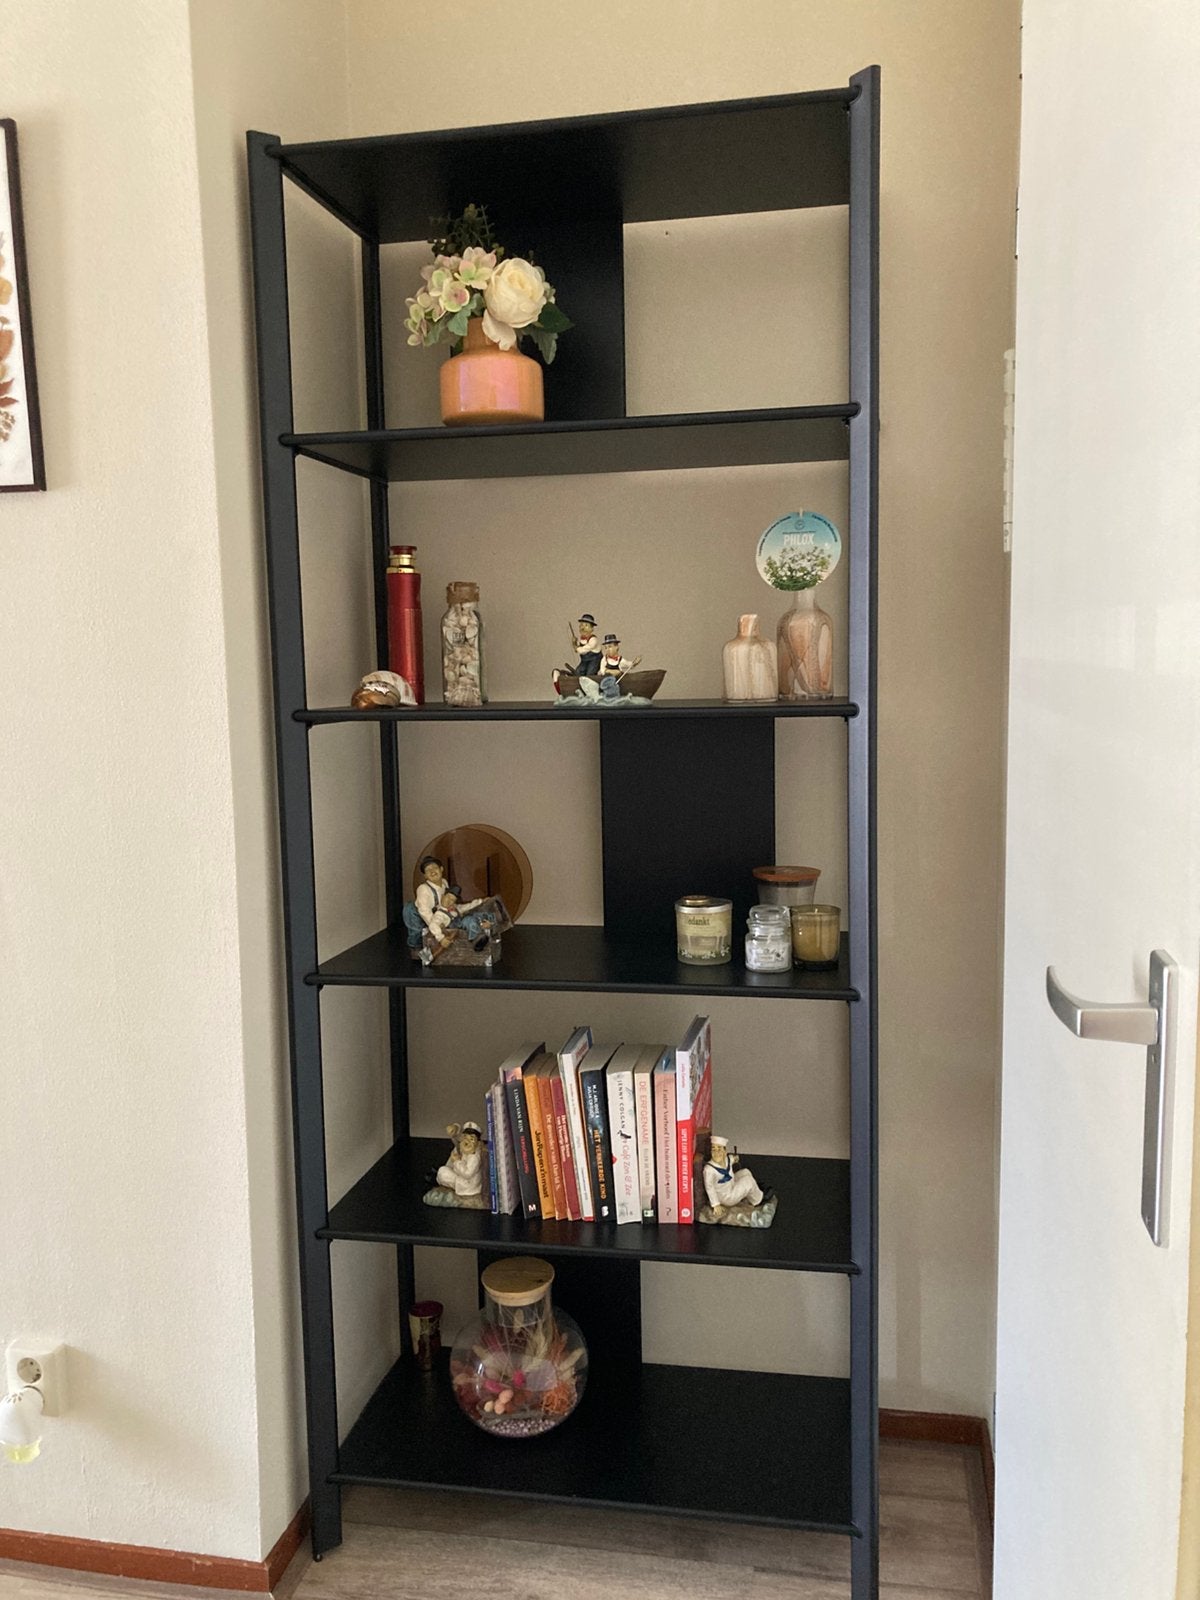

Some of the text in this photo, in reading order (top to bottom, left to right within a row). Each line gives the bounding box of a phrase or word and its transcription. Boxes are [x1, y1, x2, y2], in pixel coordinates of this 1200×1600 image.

[784, 533, 815, 546] PHLOX
[639, 1081, 649, 1144] DE ERFGENAME
[594, 1143, 605, 1182] VERKEERDE
[622, 1161, 631, 1174] Zon
[552, 1164, 560, 1183] David
[599, 1183, 607, 1199] KIND
[624, 1183, 633, 1196] Zee
